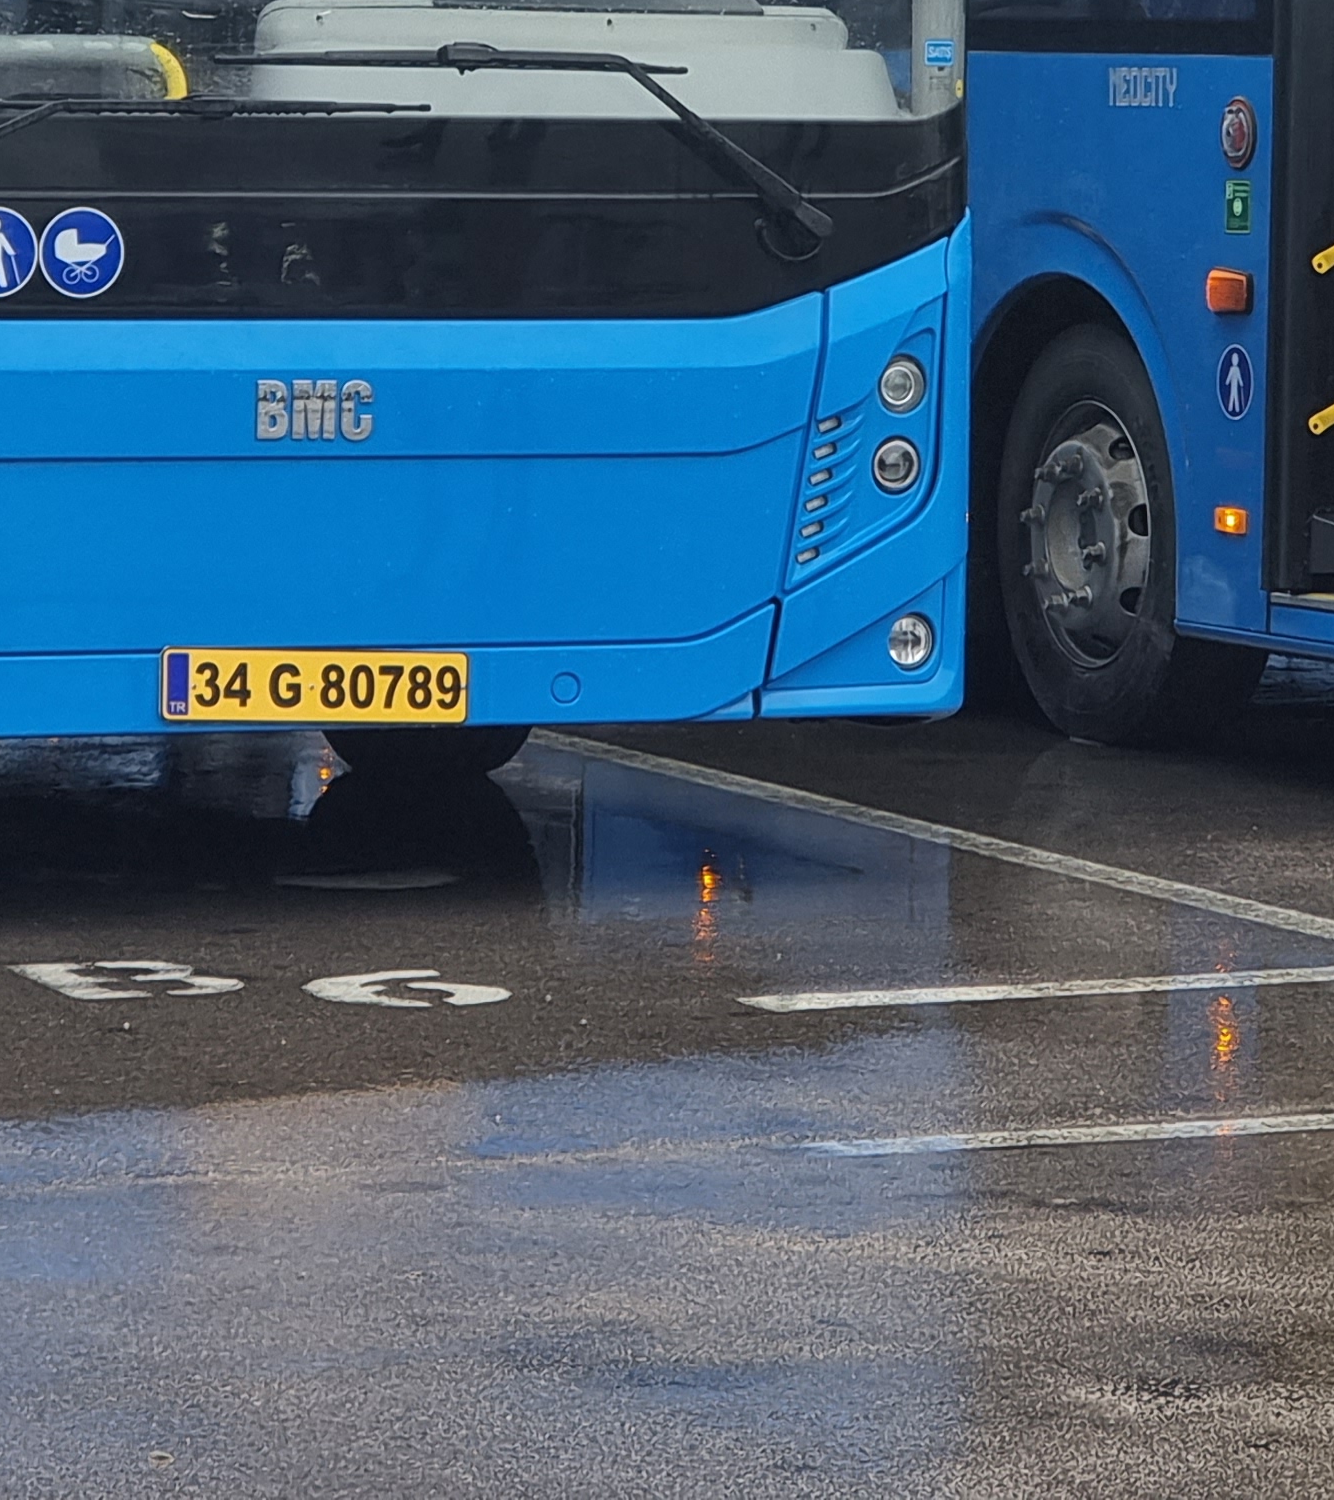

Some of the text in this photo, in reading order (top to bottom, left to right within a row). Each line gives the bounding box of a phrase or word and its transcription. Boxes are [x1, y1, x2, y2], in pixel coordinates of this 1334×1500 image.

[1108, 67, 1178, 108] NEOCITY
[256, 379, 373, 441] BMC
[168, 700, 187, 713] TR
[194, 661, 463, 711] 34 G 80789
